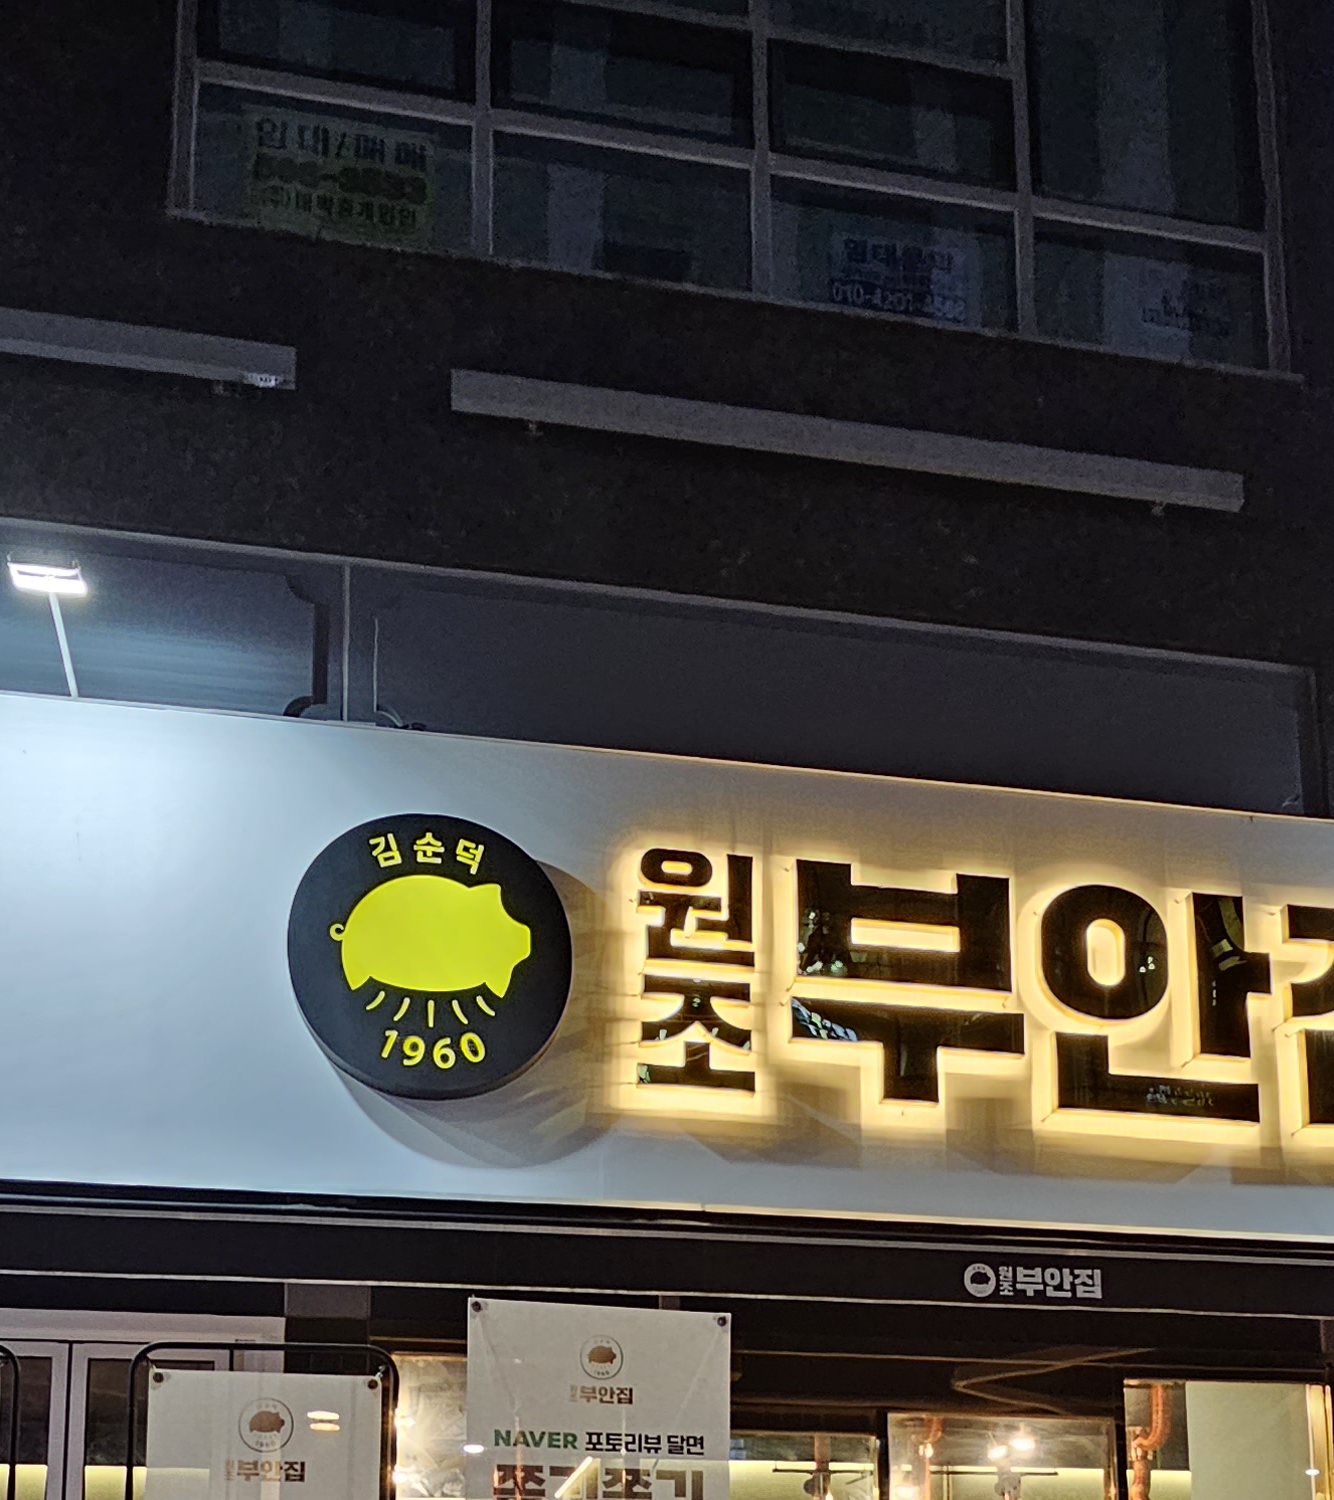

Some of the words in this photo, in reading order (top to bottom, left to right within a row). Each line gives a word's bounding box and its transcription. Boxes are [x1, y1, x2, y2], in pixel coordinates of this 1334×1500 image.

[367, 831, 488, 877] 김순덕
[636, 847, 758, 1093] 원조
[378, 1028, 489, 1073] 1960
[1015, 1265, 1103, 1300] 부안집
[579, 1385, 634, 1405] 부안집
[493, 1429, 578, 1449] NAVER
[585, 1431, 662, 1454] 포토리뷰
[667, 1434, 705, 1455] 달면
[236, 1460, 306, 1483] 부안집
